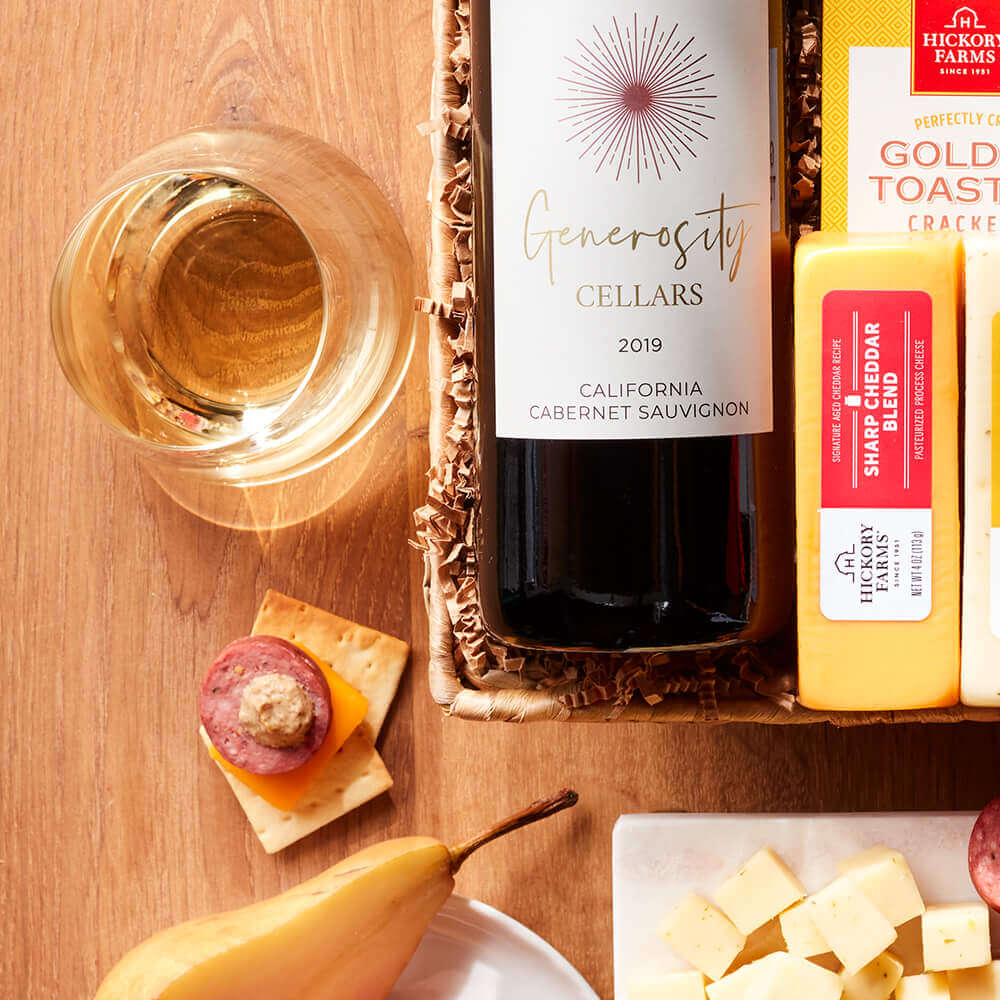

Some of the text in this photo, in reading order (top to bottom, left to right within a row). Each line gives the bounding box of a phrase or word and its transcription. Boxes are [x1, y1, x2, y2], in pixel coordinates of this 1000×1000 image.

[934, 50, 996, 63] FARMS
[914, 112, 983, 130] PERFECTLY
[524, 189, 761, 285] Generosity
[576, 282, 703, 308] CELLARS
[618, 337, 663, 354] 2019
[831, 338, 842, 365] RECIPE
[579, 380, 703, 399] CALIFORNIA
[831, 366, 842, 400] CHEDDAR
[529, 400, 750, 421] CABERNET SAUVIGNON
[864, 322, 880, 476] SHARP CHEDDAR
[883, 372, 898, 432] BLEND
[914, 339, 925, 460] PASTEURIZED PROCESS CHEESE
[831, 423, 842, 463] SIGNATURE
[860, 523, 873, 604] HICKORY
[876, 534, 889, 592] FARMS
[911, 555, 922, 564] OZ
[911, 572, 922, 583] WT
[911, 584, 922, 597] NET
